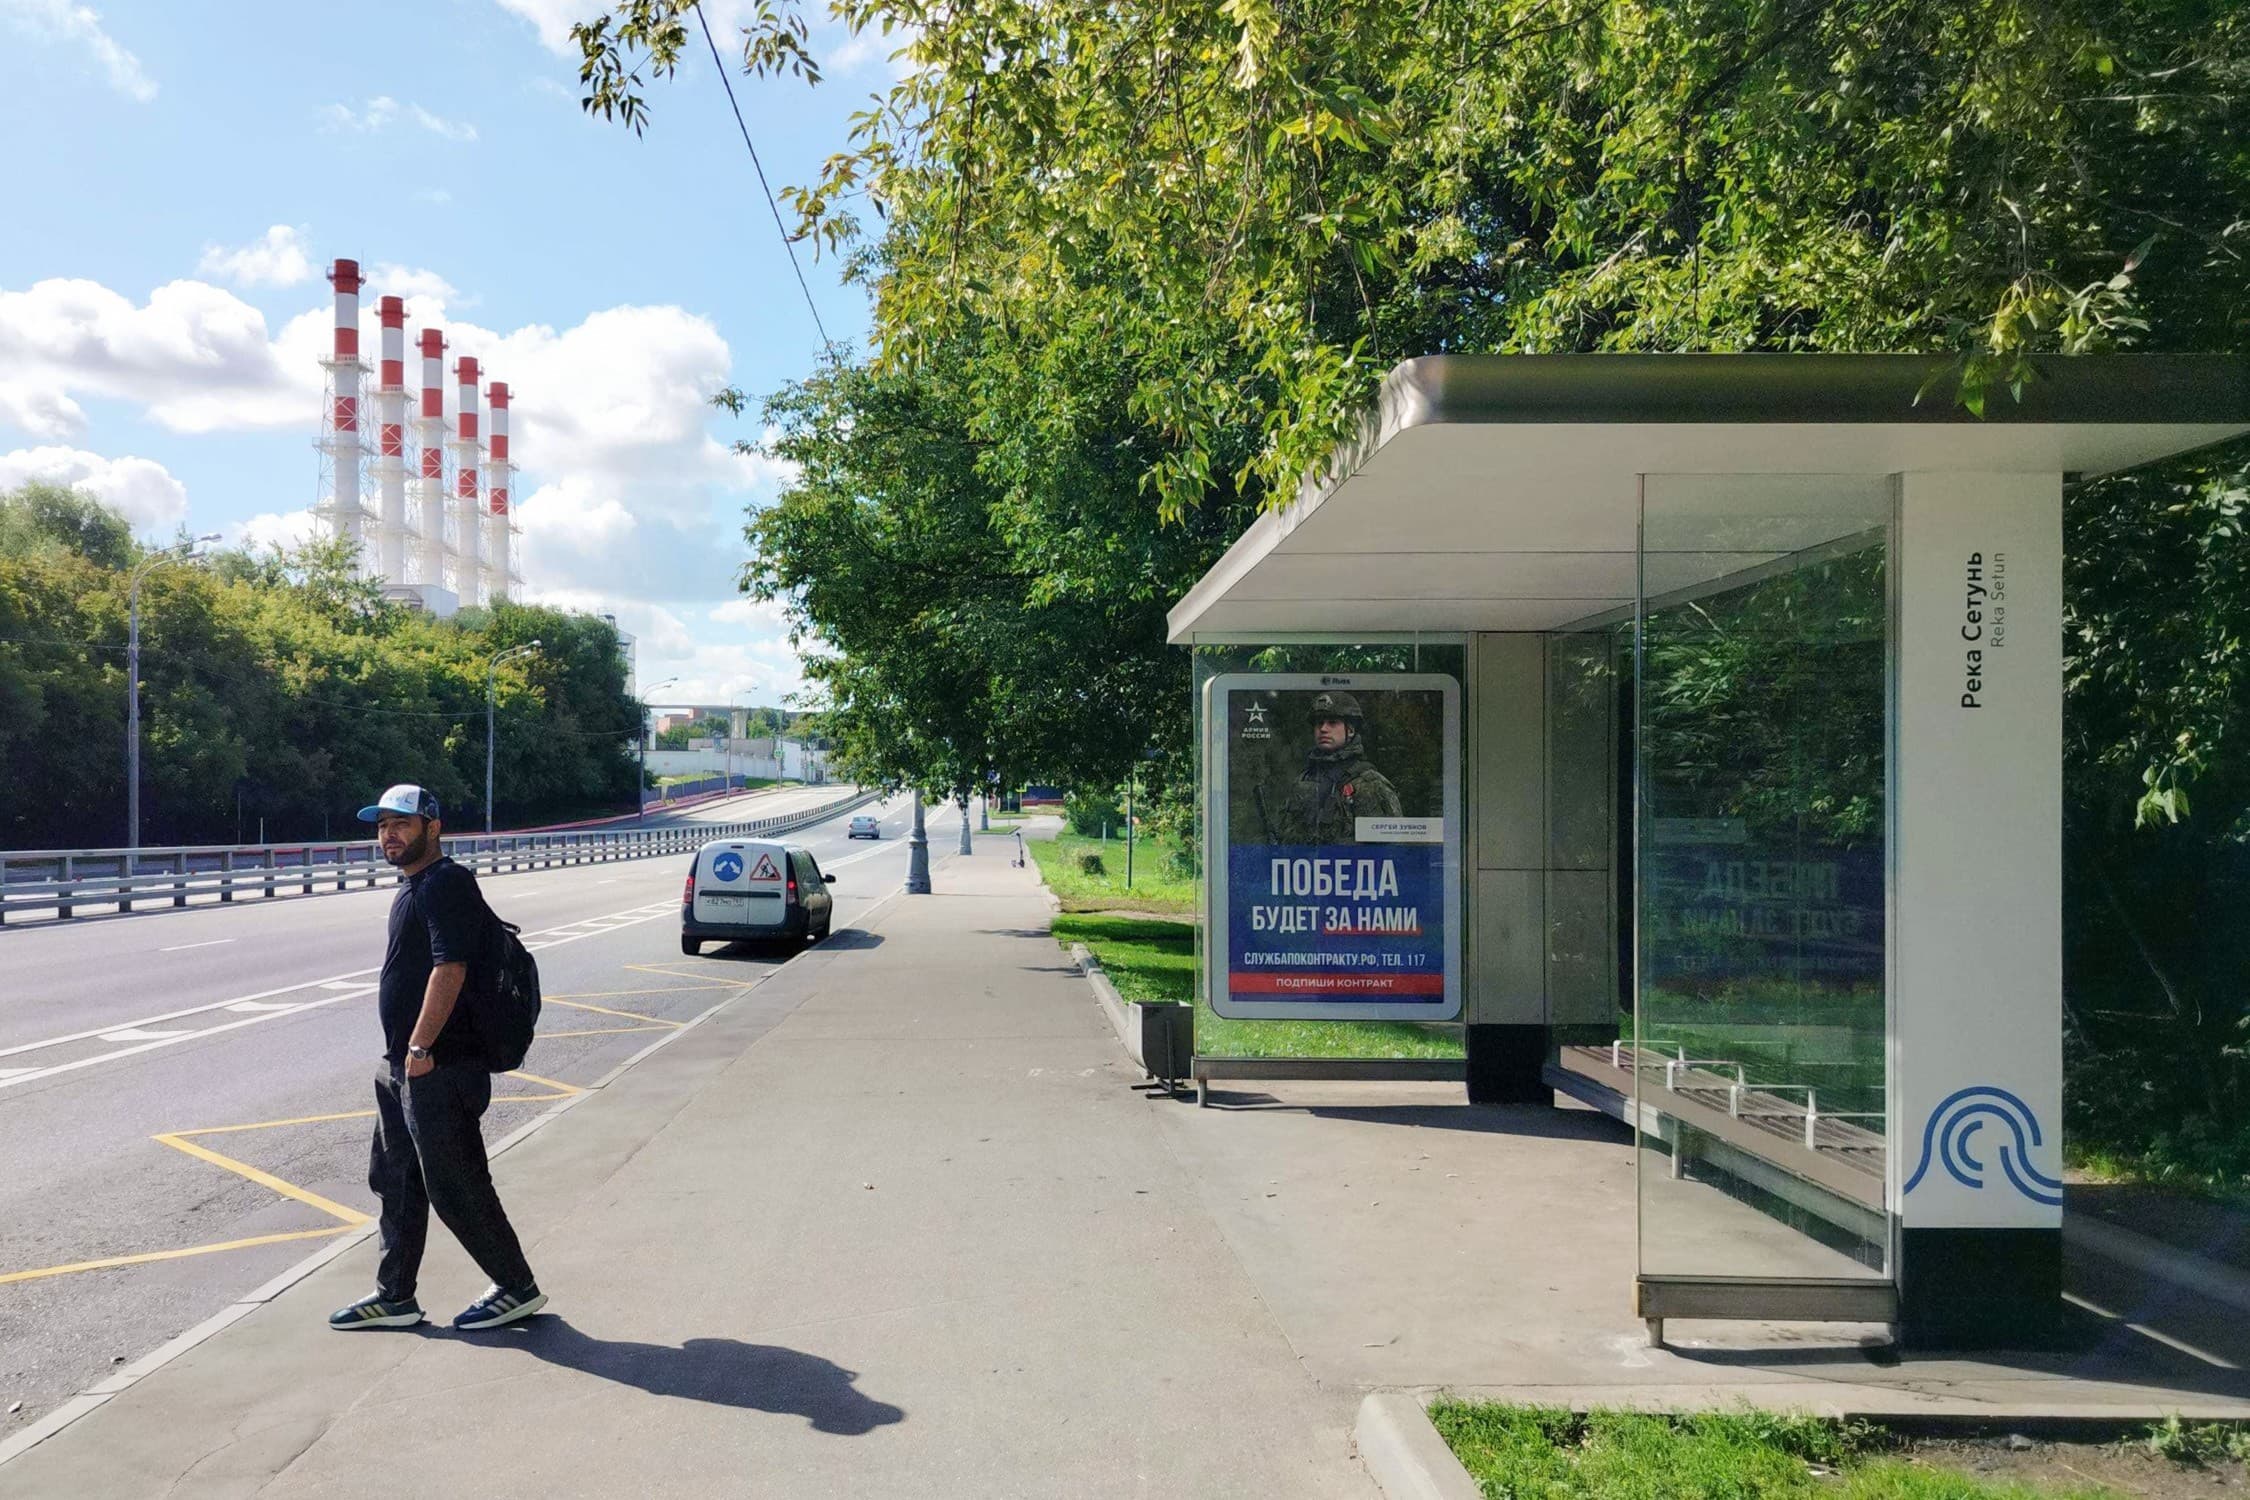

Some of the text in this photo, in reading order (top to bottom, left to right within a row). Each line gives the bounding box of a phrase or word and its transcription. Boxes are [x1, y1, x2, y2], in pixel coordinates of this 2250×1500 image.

[1991, 553, 2005, 647] Reka Setun
[1962, 551, 1987, 708] Река Сетунь
[1371, 822, 1398, 830] СЕРГЕЙ
[1271, 858, 1399, 901] ПОБЕДА
[1252, 905, 1417, 933] БУДЕТ ЗА НАМИ
[1244, 952, 1425, 967] СЛУЖБАПОКОНТРАКТУ.РФ, ТЕЛ. 117
[1276, 978, 1393, 989] ПОДПИШИ КОНТРАКТ
